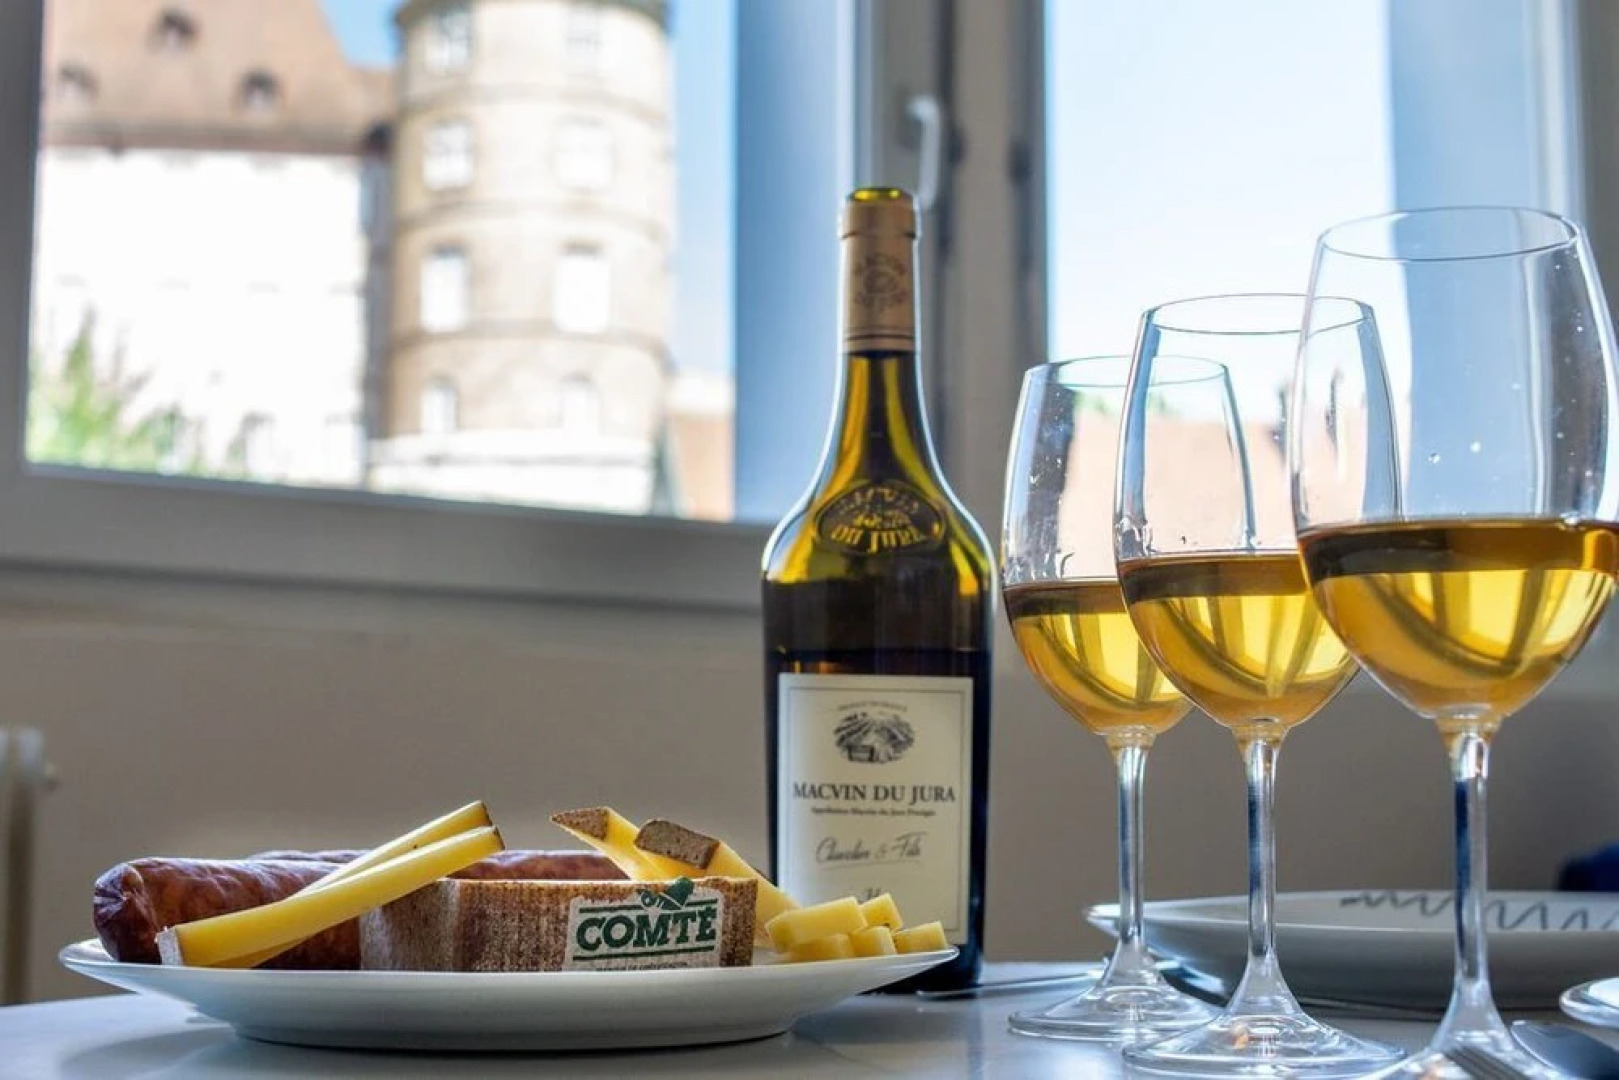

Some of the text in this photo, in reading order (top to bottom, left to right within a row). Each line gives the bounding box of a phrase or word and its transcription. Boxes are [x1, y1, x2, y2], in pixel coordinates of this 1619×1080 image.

[793, 782, 956, 805] MACVIN DU JURA
[576, 906, 718, 951] COMTÉ
